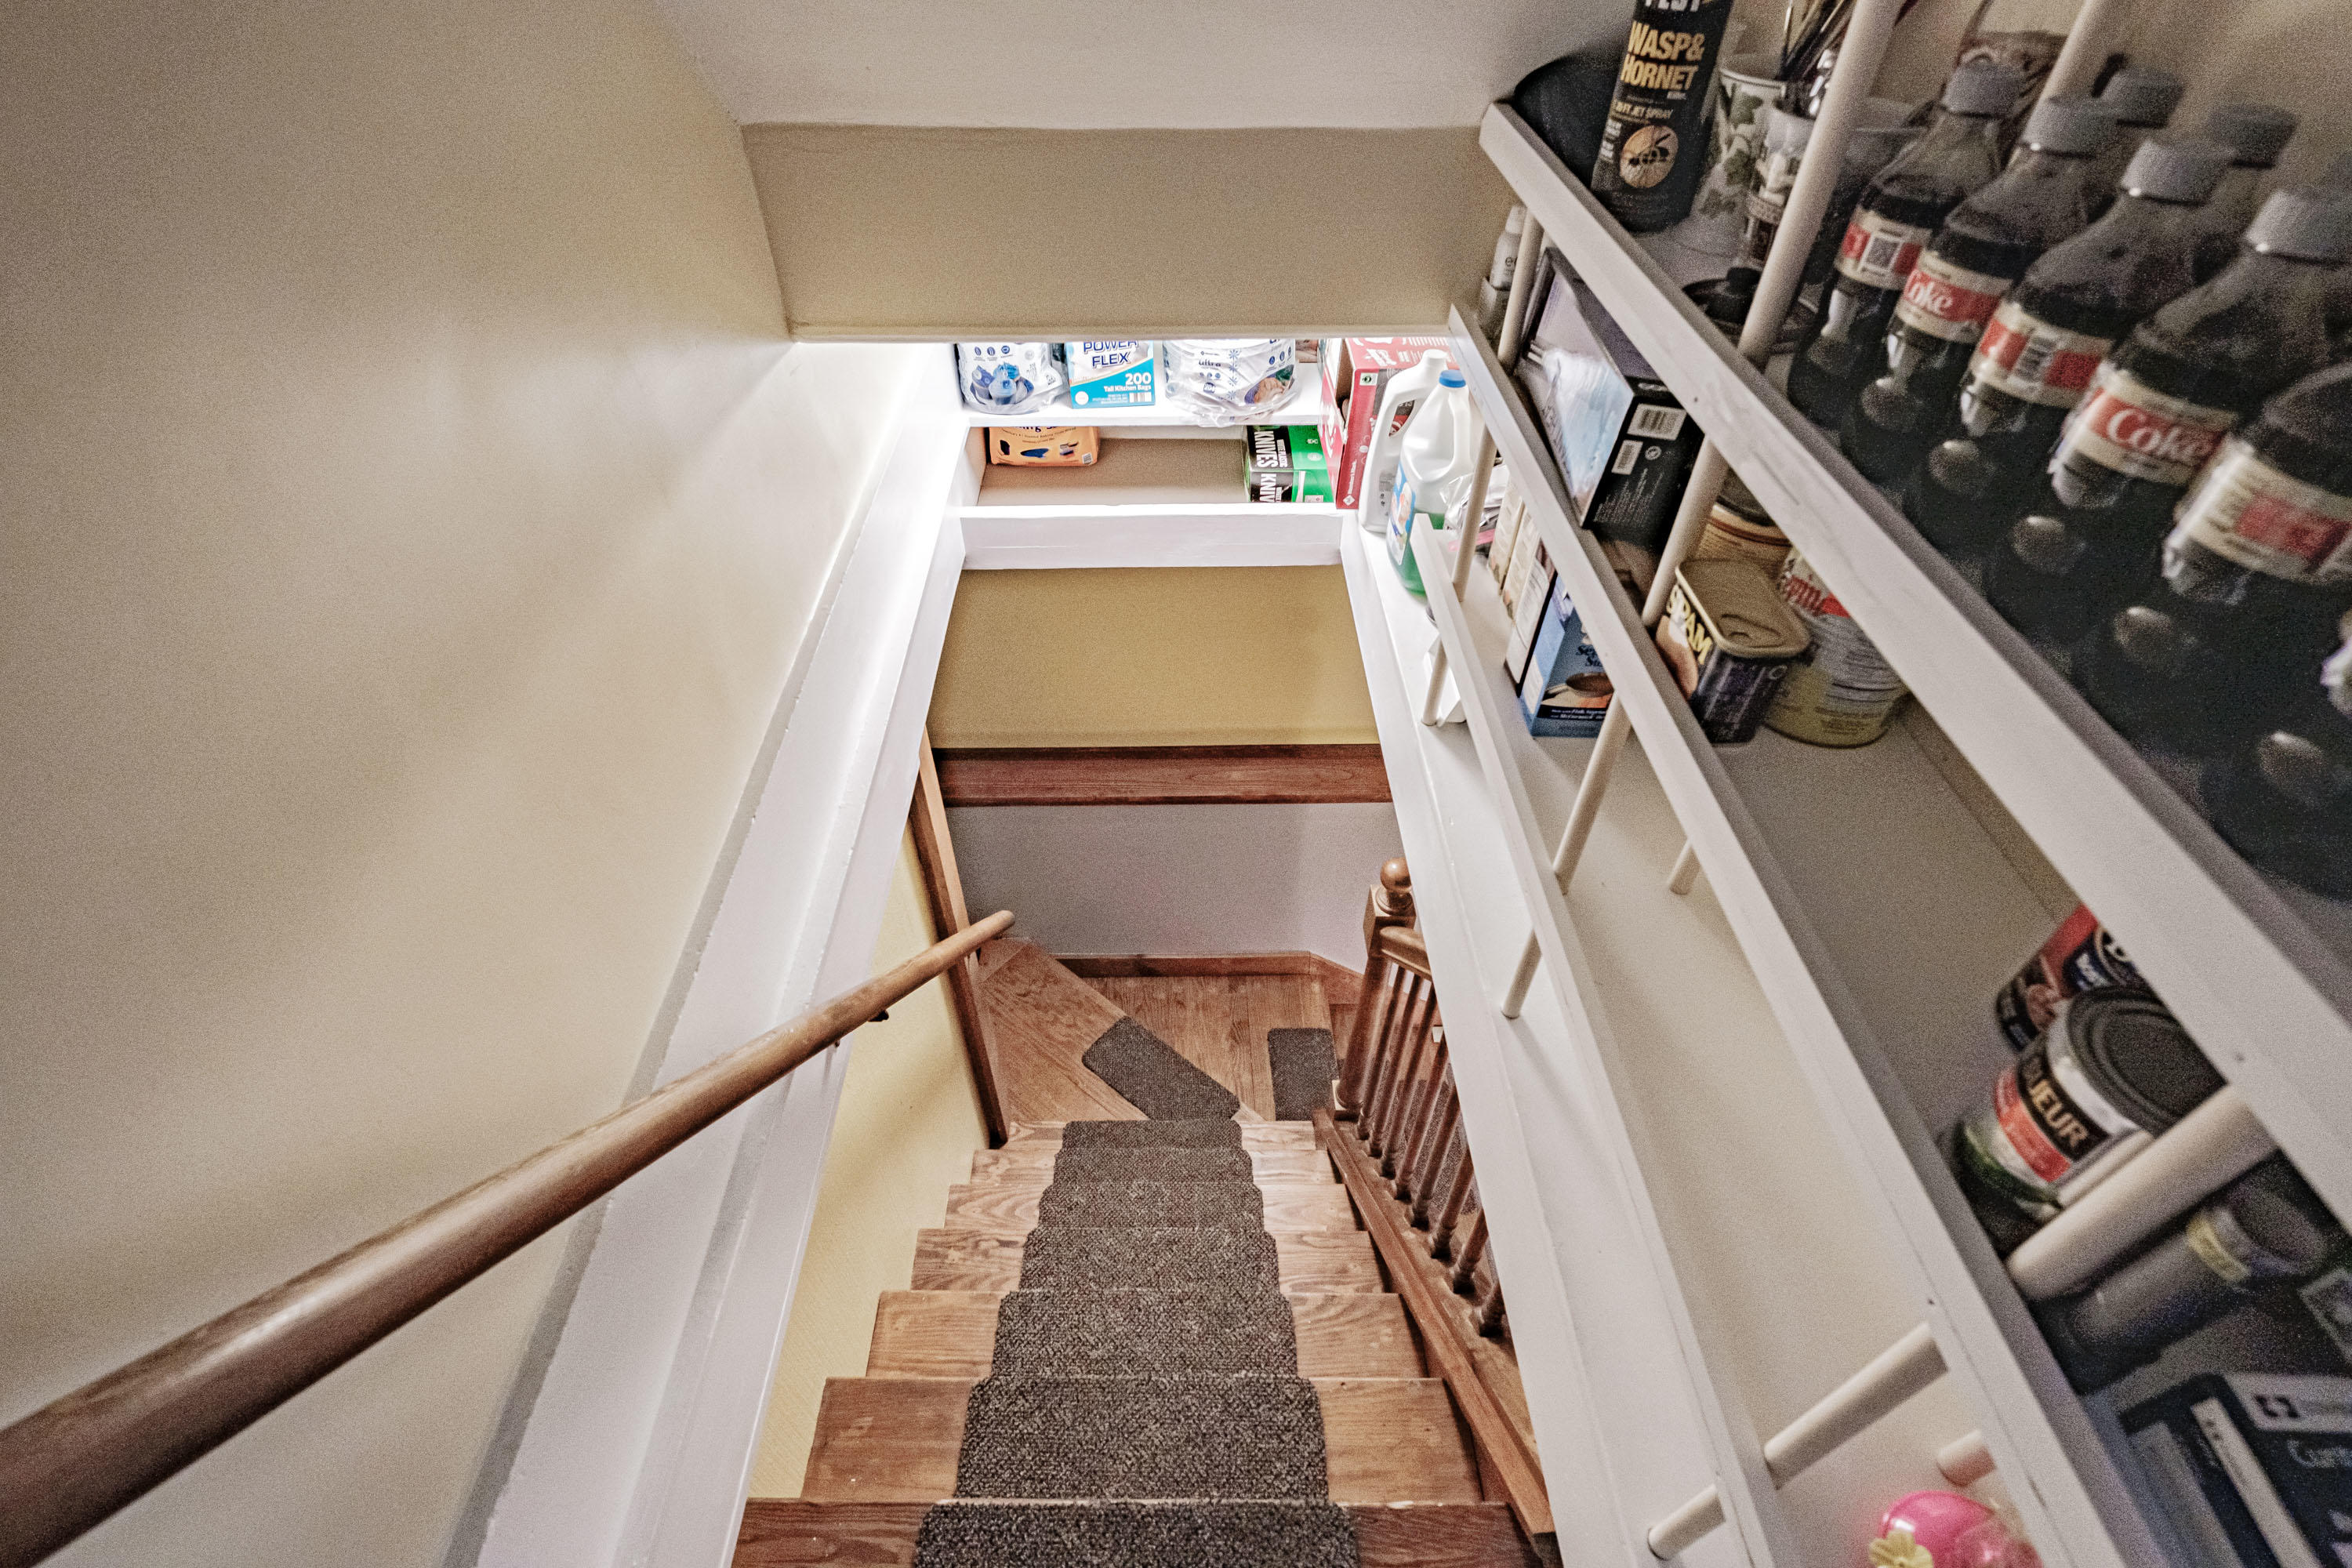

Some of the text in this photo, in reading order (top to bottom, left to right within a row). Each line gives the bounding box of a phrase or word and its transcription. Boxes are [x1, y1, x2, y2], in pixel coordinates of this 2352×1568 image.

[1621, 53, 1699, 91] HORNET
[1092, 352, 1129, 367] FLEX
[1125, 372, 1152, 385] 200
[1254, 430, 1278, 468] KNIVES
[2106, 408, 2214, 464] Coke
[1259, 474, 1277, 503] KNIV
[1666, 583, 1713, 666] SPAM
